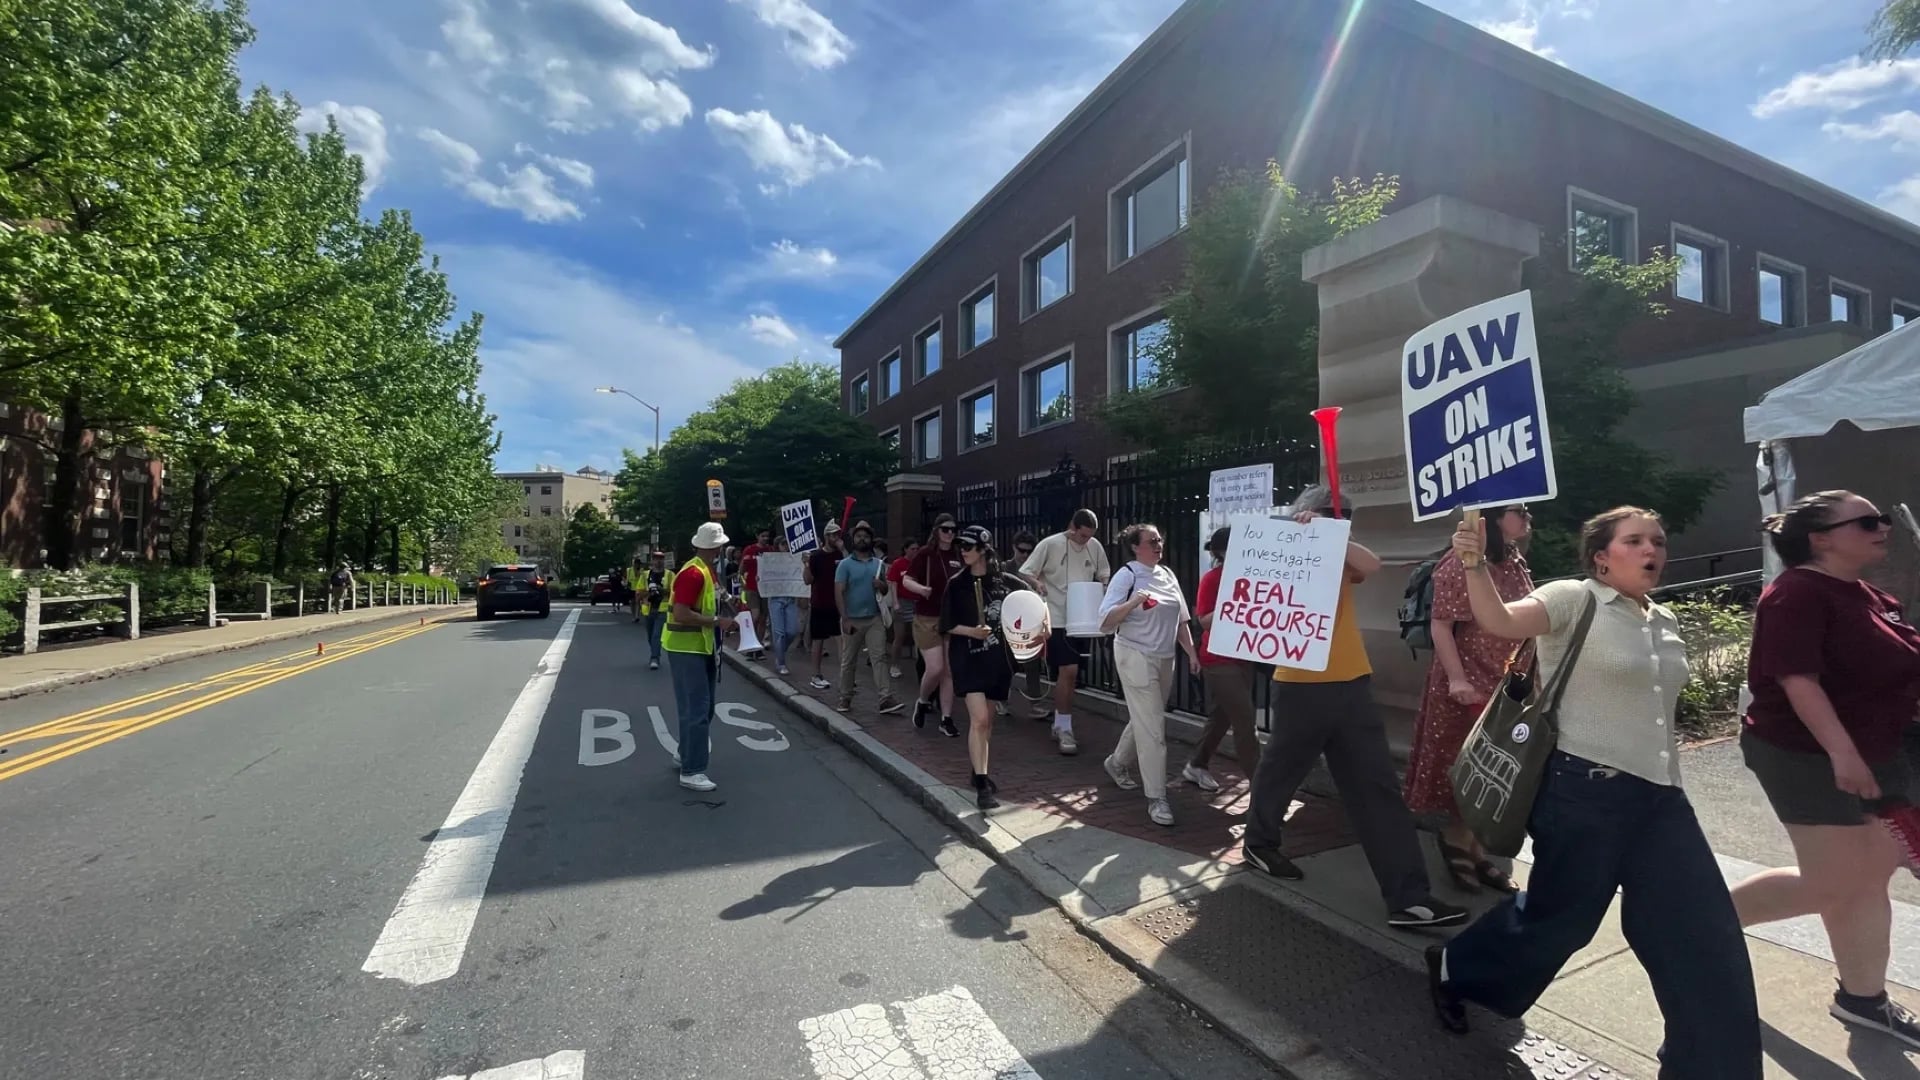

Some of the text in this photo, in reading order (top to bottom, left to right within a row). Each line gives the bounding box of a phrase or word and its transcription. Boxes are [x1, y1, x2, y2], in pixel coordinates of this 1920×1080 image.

[1408, 312, 1520, 391] UAW
[1444, 385, 1489, 444] ON
[1418, 415, 1536, 508] STRIKE
[783, 504, 809, 522] UAW
[790, 529, 814, 553] STRIKE
[793, 521, 805, 536] ON
[1243, 524, 1263, 540] You
[1277, 528, 1321, 544] can't
[1242, 547, 1322, 568] investigate
[1232, 578, 1306, 608] REAL
[1220, 601, 1331, 641] RECOURSE
[1236, 631, 1310, 662] NOW
